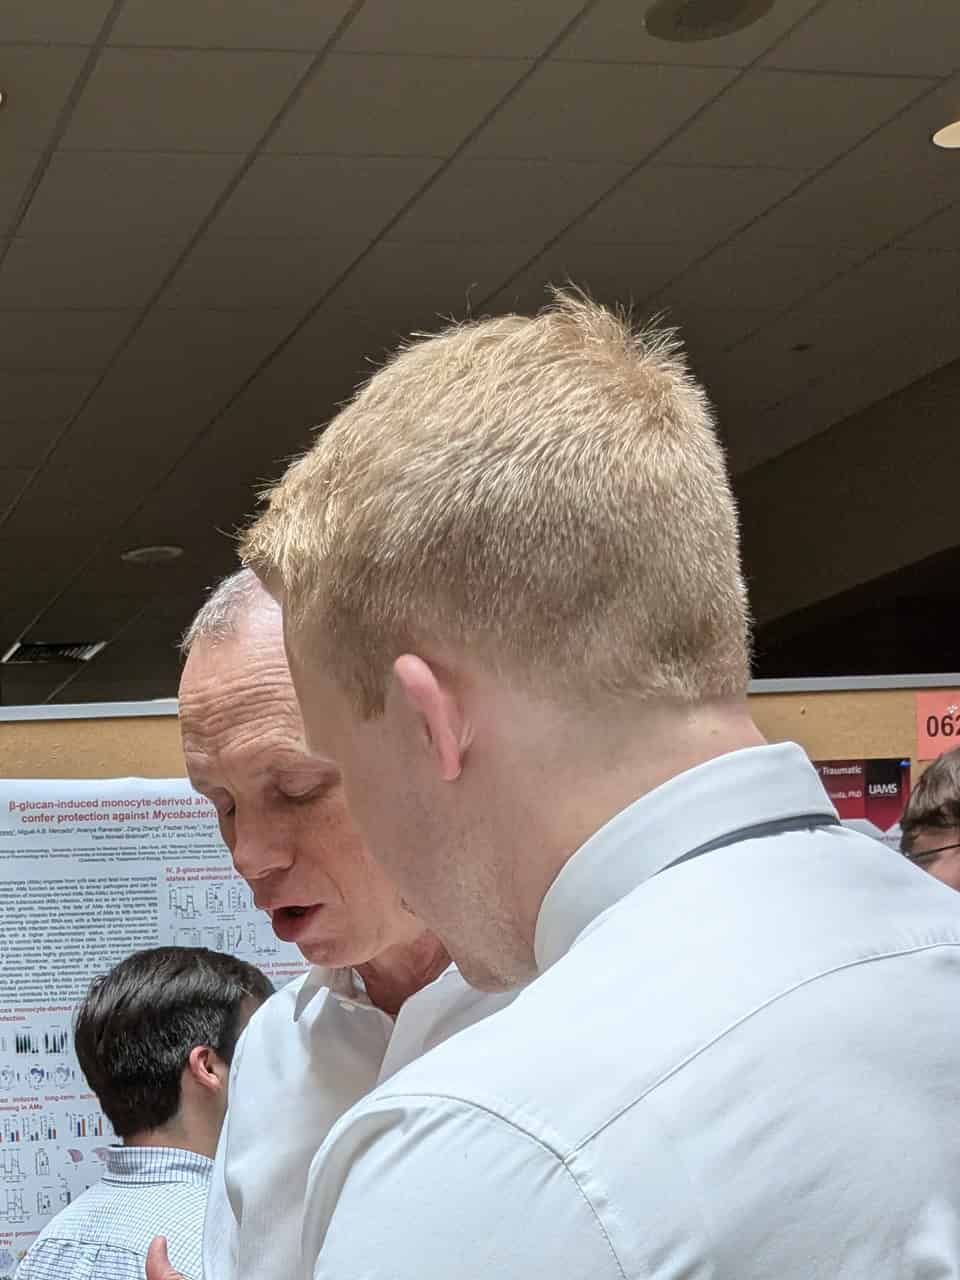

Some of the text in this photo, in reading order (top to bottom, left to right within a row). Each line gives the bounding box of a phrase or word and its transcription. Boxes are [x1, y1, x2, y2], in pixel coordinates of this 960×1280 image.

[822, 764, 863, 776] Traumatic
[869, 783, 898, 795] UAMS
[8, 798, 99, 812] β-glucan-induced
[101, 796, 192, 810] monocyte-derived
[22, 813, 55, 824] confer
[57, 811, 109, 825] protection
[112, 810, 149, 823] against
